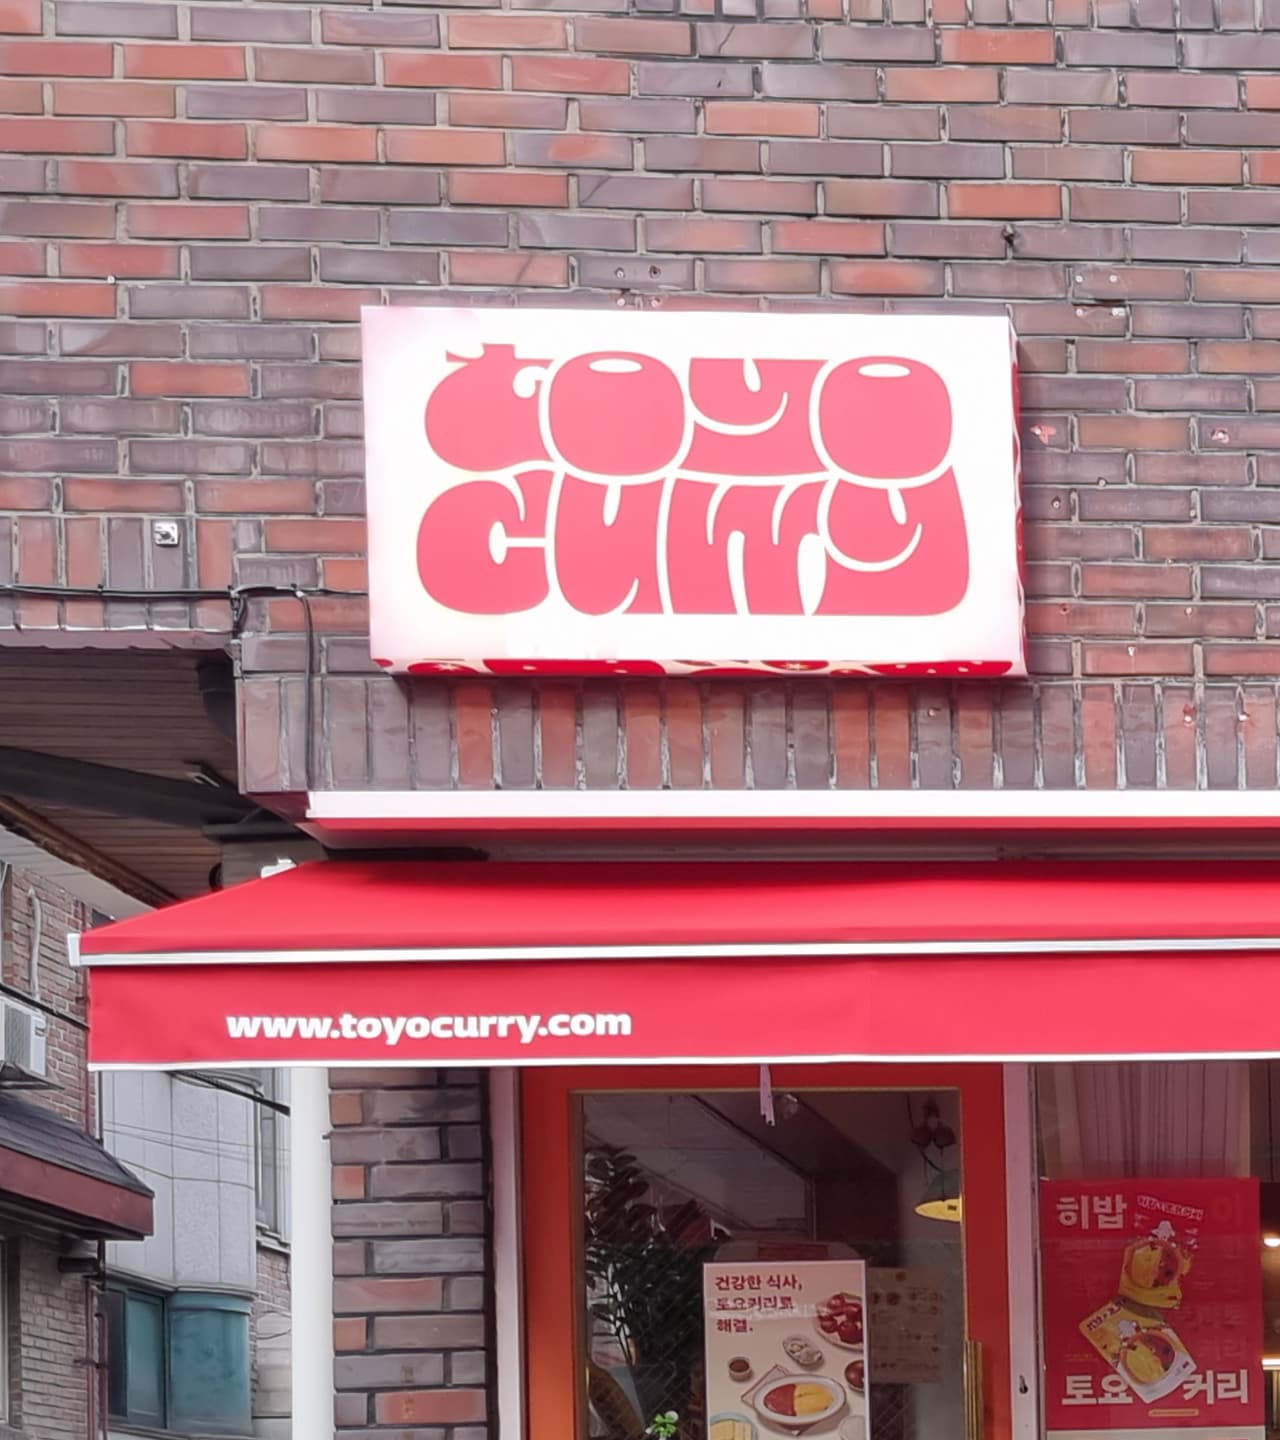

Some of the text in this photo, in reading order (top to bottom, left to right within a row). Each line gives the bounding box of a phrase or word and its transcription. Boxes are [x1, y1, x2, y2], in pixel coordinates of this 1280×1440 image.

[226, 1013, 632, 1046] www.toyocurry.com
[1056, 1194, 1127, 1230] 히밥
[715, 1274, 802, 1291] 건강한 식사,
[716, 1296, 794, 1312] 토요커리로
[716, 1318, 753, 1333] 해결.
[1062, 1369, 1249, 1405] 토요 커리
